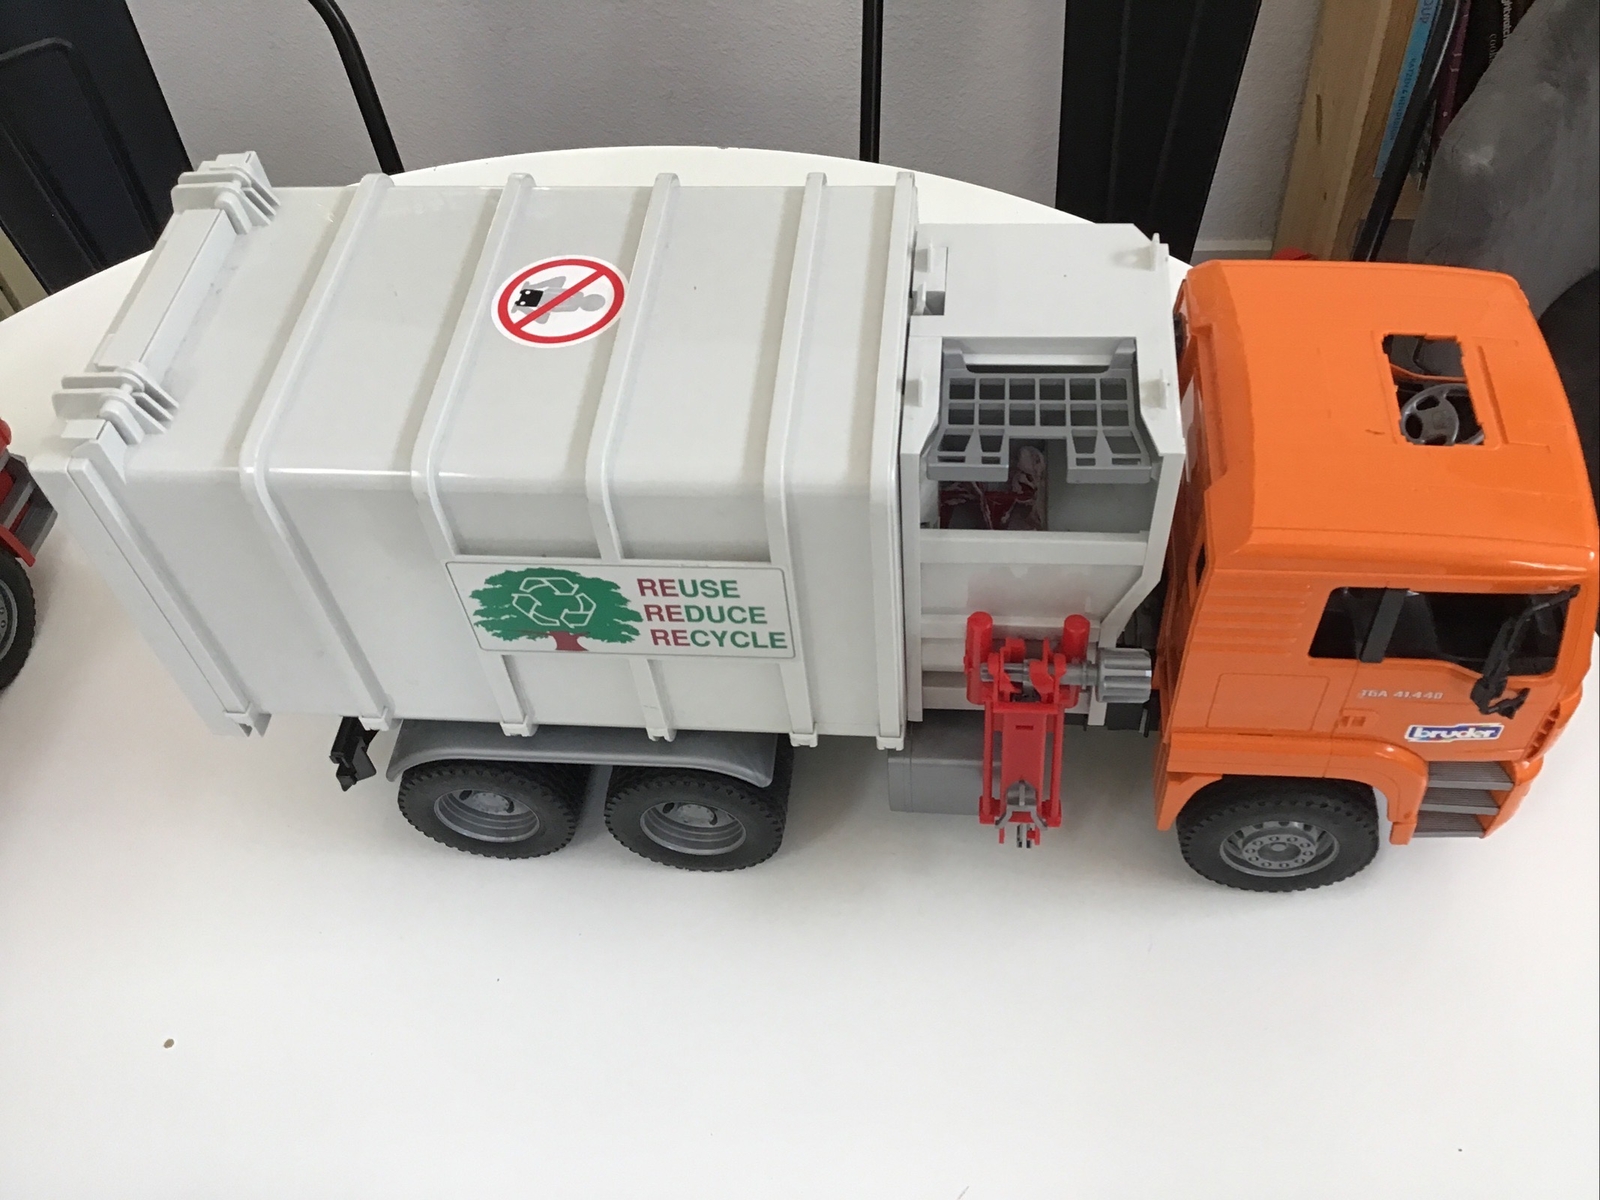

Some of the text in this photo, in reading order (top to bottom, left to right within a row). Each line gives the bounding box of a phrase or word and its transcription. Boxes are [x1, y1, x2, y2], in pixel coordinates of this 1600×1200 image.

[637, 578, 741, 599] REUSE
[643, 604, 768, 624] REDUCE
[650, 628, 788, 649] RECYCLE
[1359, 689, 1444, 700] TGA 41.440
[1413, 727, 1497, 739] bruder
